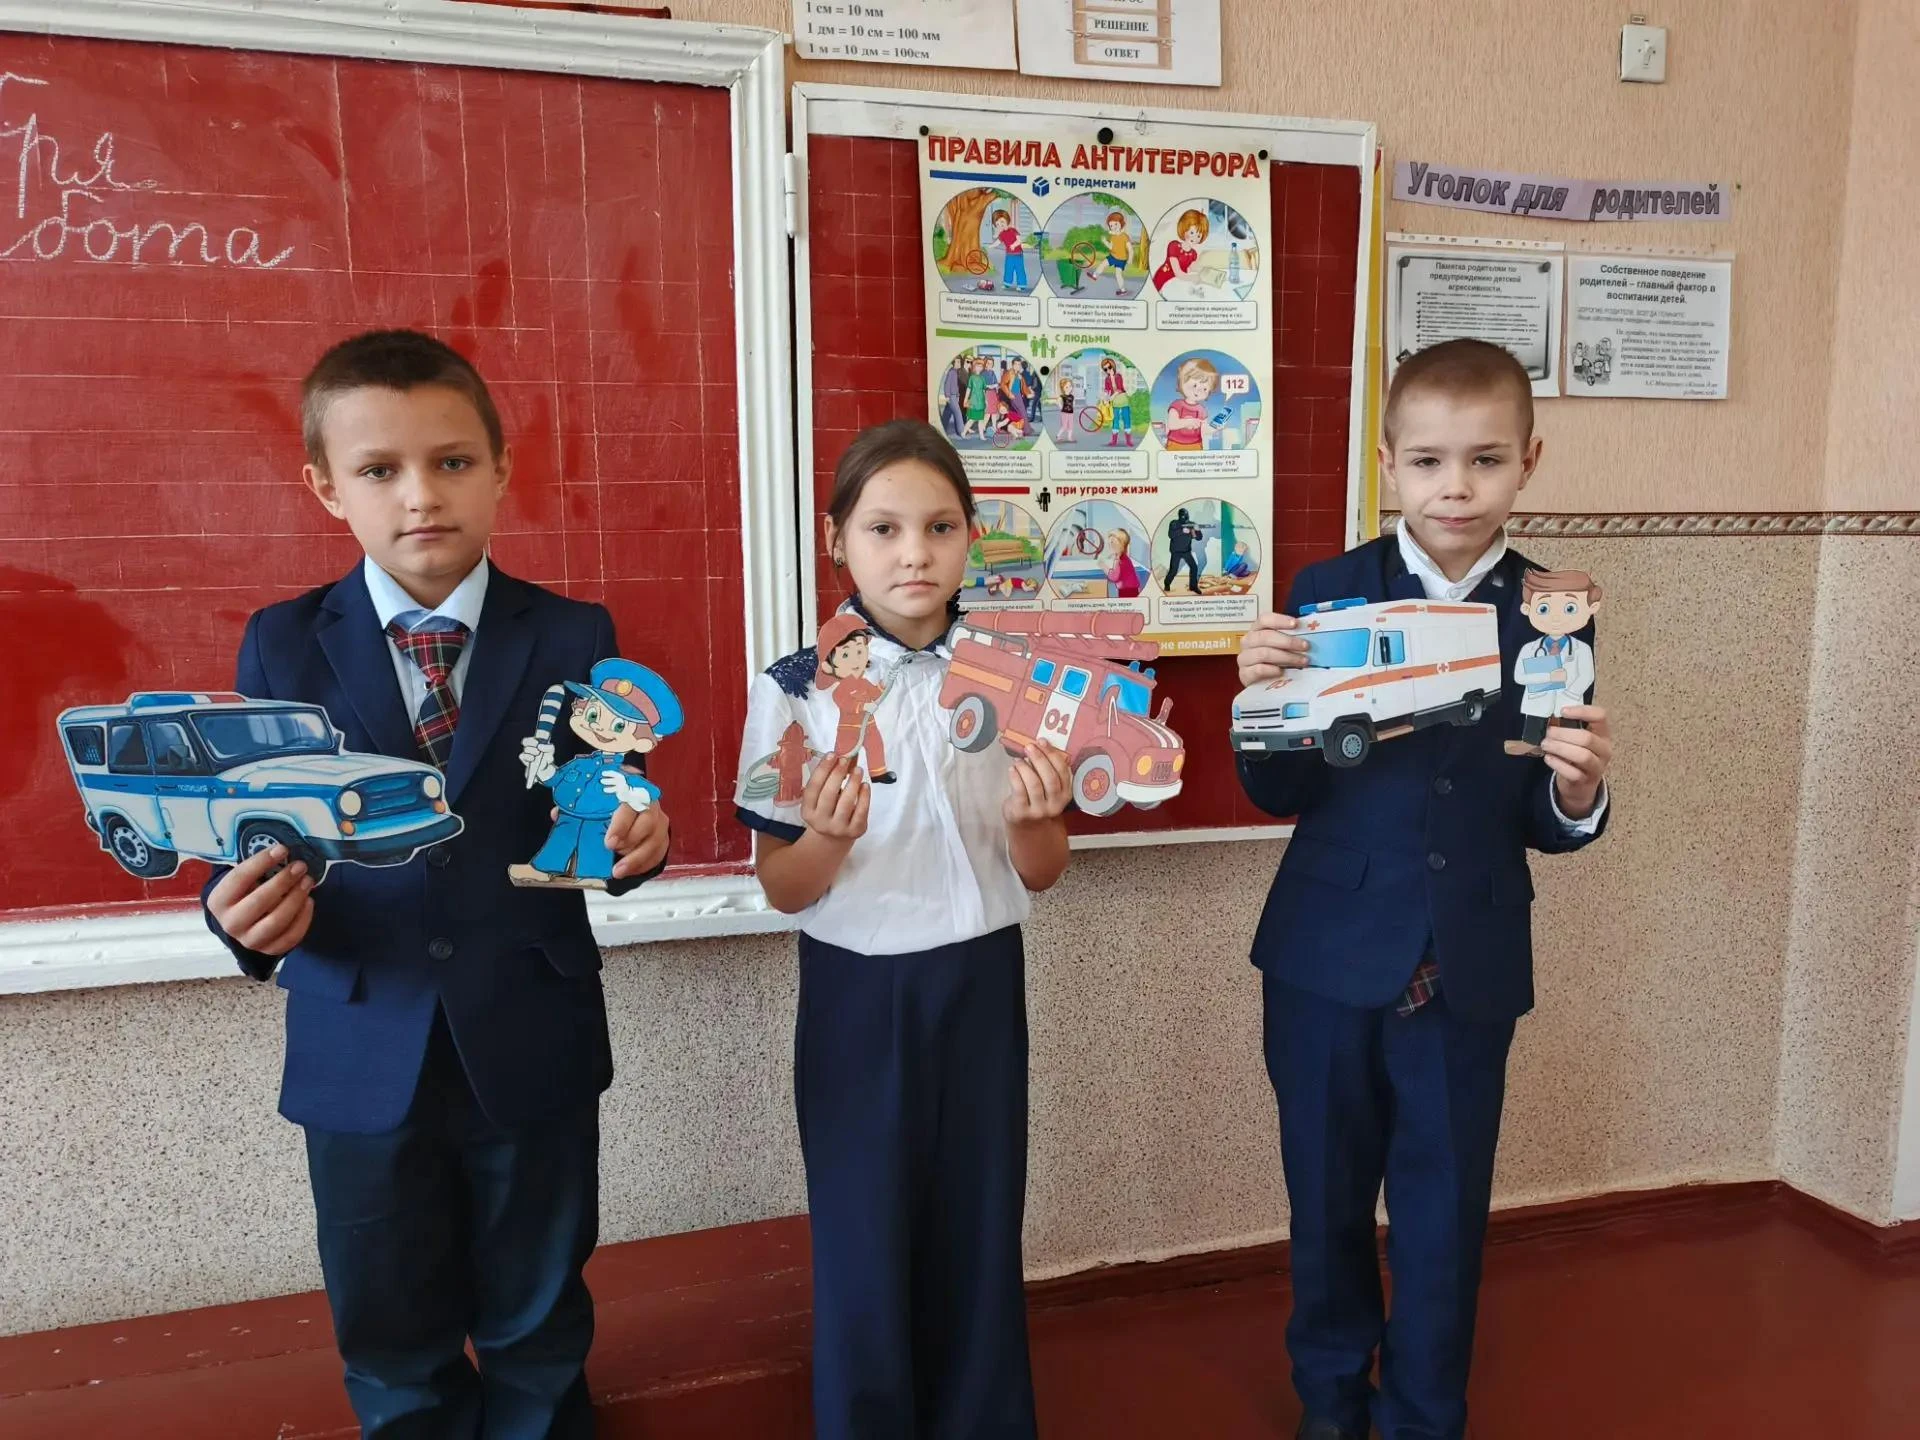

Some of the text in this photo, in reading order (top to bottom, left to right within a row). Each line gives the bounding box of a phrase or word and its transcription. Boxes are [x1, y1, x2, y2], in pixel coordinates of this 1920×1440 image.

[807, 2, 811, 13] 1
[816, 5, 832, 14] см
[849, 4, 861, 16] 10
[865, 9, 884, 17] мм
[808, 23, 813, 34] 1
[817, 26, 835, 36] дм
[851, 26, 864, 36] 10
[868, 30, 883, 38] см
[899, 29, 918, 39] 100
[922, 32, 940, 41] мм
[1094, 19, 1149, 32] РЕШЕНИЕ
[809, 43, 814, 53] 1
[845, 45, 857, 55] 10
[862, 47, 878, 57] дм
[894, 47, 929, 59] 100см
[1105, 47, 1140, 58] ОТВЕТ
[928, 134, 1260, 178] ПРАВИЛА АНТИТЕРРОРА
[1055, 176, 1137, 190] с предметами
[1407, 161, 1720, 221] Уголок для родителей
[1436, 262, 1465, 270] Памятка
[1468, 264, 1506, 272] родителям
[1600, 264, 1706, 280] Собственное поведение
[1430, 273, 1492, 281] предупреждению
[1580, 277, 1628, 287] родителей
[1637, 281, 1674, 290] главный
[1676, 282, 1708, 293] фактор
[1607, 292, 1687, 304] воспитании детей.
[1055, 333, 1110, 345] с людьми
[1225, 378, 1244, 389] 112
[1056, 484, 1159, 497] при угрозе жизни
[1178, 637, 1231, 650] попадай!
[1044, 708, 1071, 736] 01
